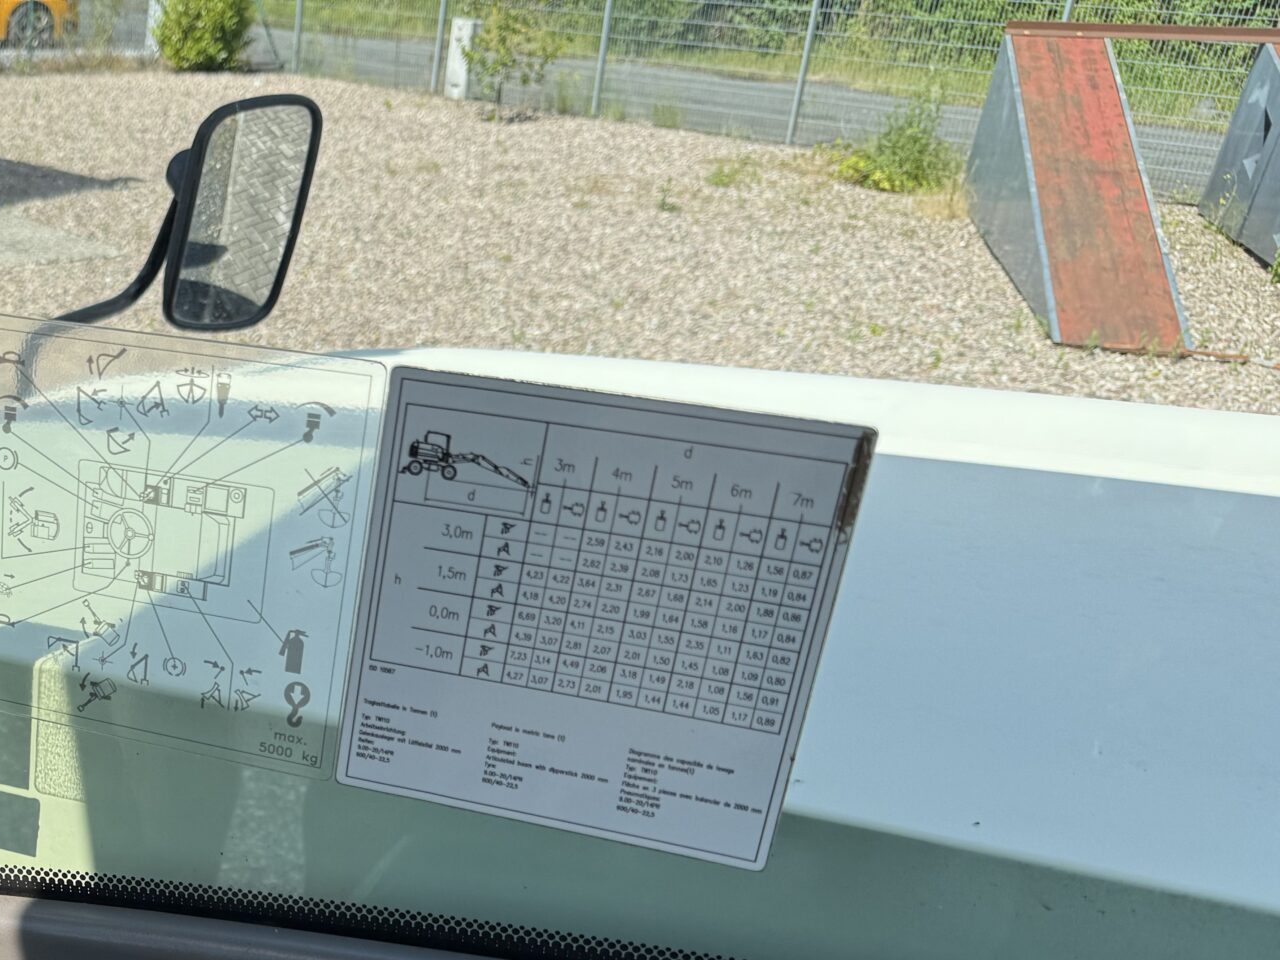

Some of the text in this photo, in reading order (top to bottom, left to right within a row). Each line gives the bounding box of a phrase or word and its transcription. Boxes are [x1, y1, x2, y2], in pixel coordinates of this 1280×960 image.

[683, 445, 694, 459] d
[554, 458, 815, 509] 3m 4m 5m 6m 7m
[467, 489, 476, 502] d
[441, 523, 473, 540] 3,0m
[394, 573, 402, 585] h
[437, 565, 467, 581] 1,5m
[429, 604, 460, 621] 0,0m
[415, 644, 453, 660] -1,0m
[274, 731, 308, 746] max.
[258, 742, 318, 766] 5000 kg
